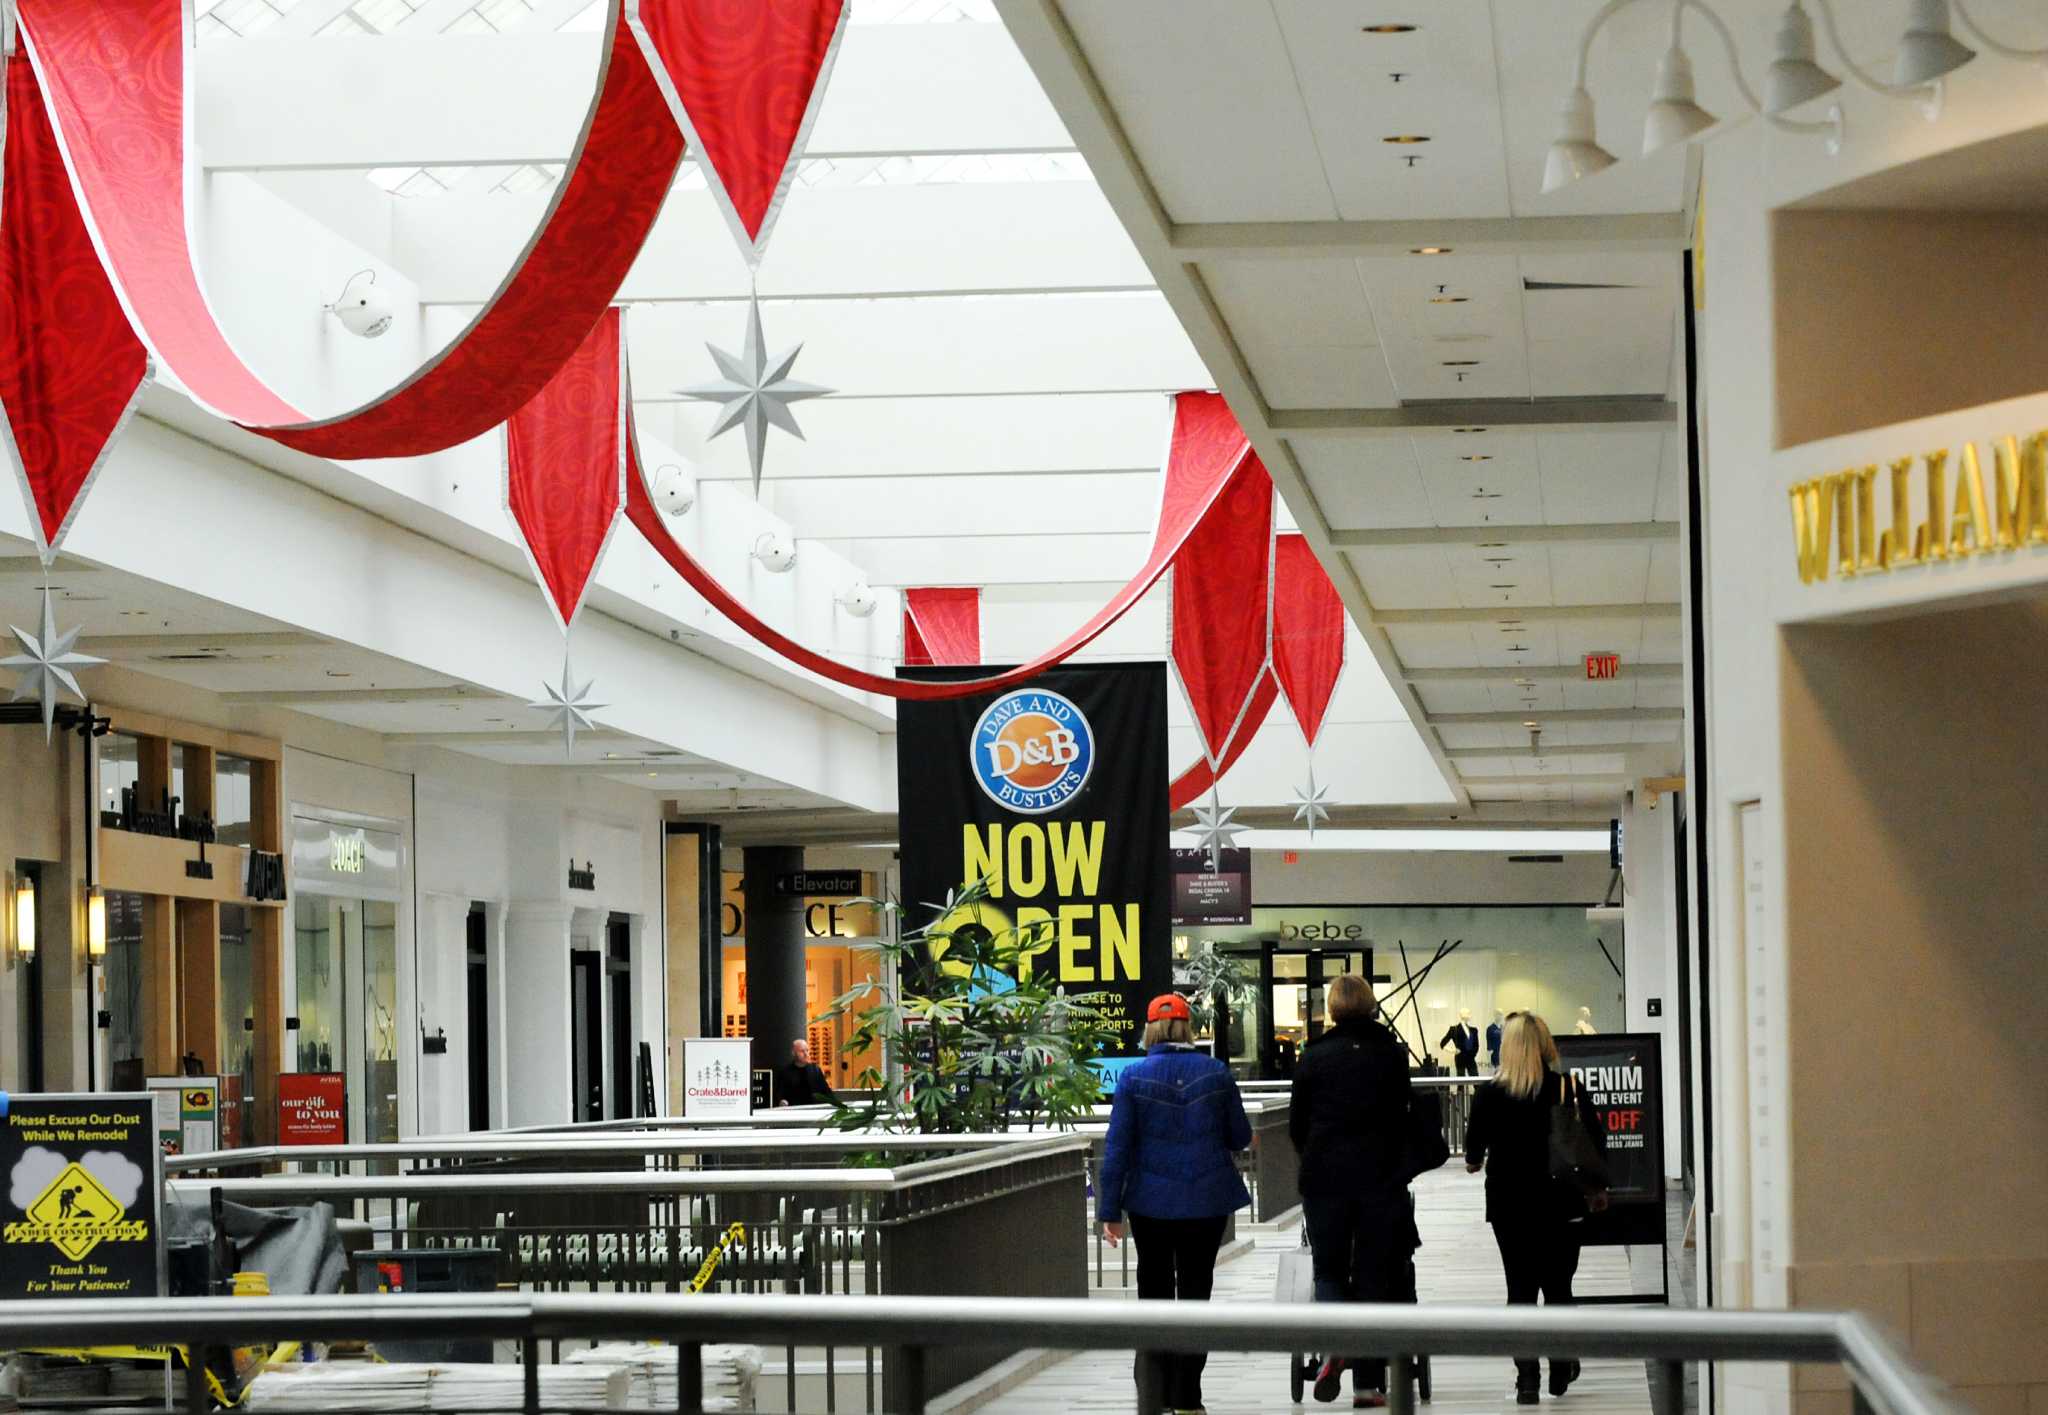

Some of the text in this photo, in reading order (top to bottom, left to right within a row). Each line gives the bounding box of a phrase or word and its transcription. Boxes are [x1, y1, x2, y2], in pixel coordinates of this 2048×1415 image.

[1586, 656, 1617, 679] EXIT
[983, 696, 1070, 736] DAVE AND
[984, 728, 1080, 778] D&B
[998, 770, 1080, 807] BUSTER'S
[963, 821, 1106, 898] NOW
[793, 875, 856, 891] Elevator
[1279, 920, 1363, 940] bebe
[928, 902, 1141, 984] OPEN
[1109, 994, 1122, 1003] TO
[1101, 1007, 1126, 1017] PLAY
[1094, 1020, 1134, 1031] SPORTS
[1570, 1066, 1643, 1092] DENIM
[282, 1095, 325, 1110] our gift
[1611, 1091, 1643, 1104] EVENT
[10, 1113, 140, 1126] Please Excuse Our Dust
[296, 1110, 340, 1123] to you
[1607, 1110, 1641, 1131] OFF
[22, 1129, 128, 1141] While We Remodel
[11, 1226, 141, 1237] UNDER CONSTRUCTION
[50, 1264, 108, 1275] Thank You
[26, 1279, 130, 1292] For Your Patience!
